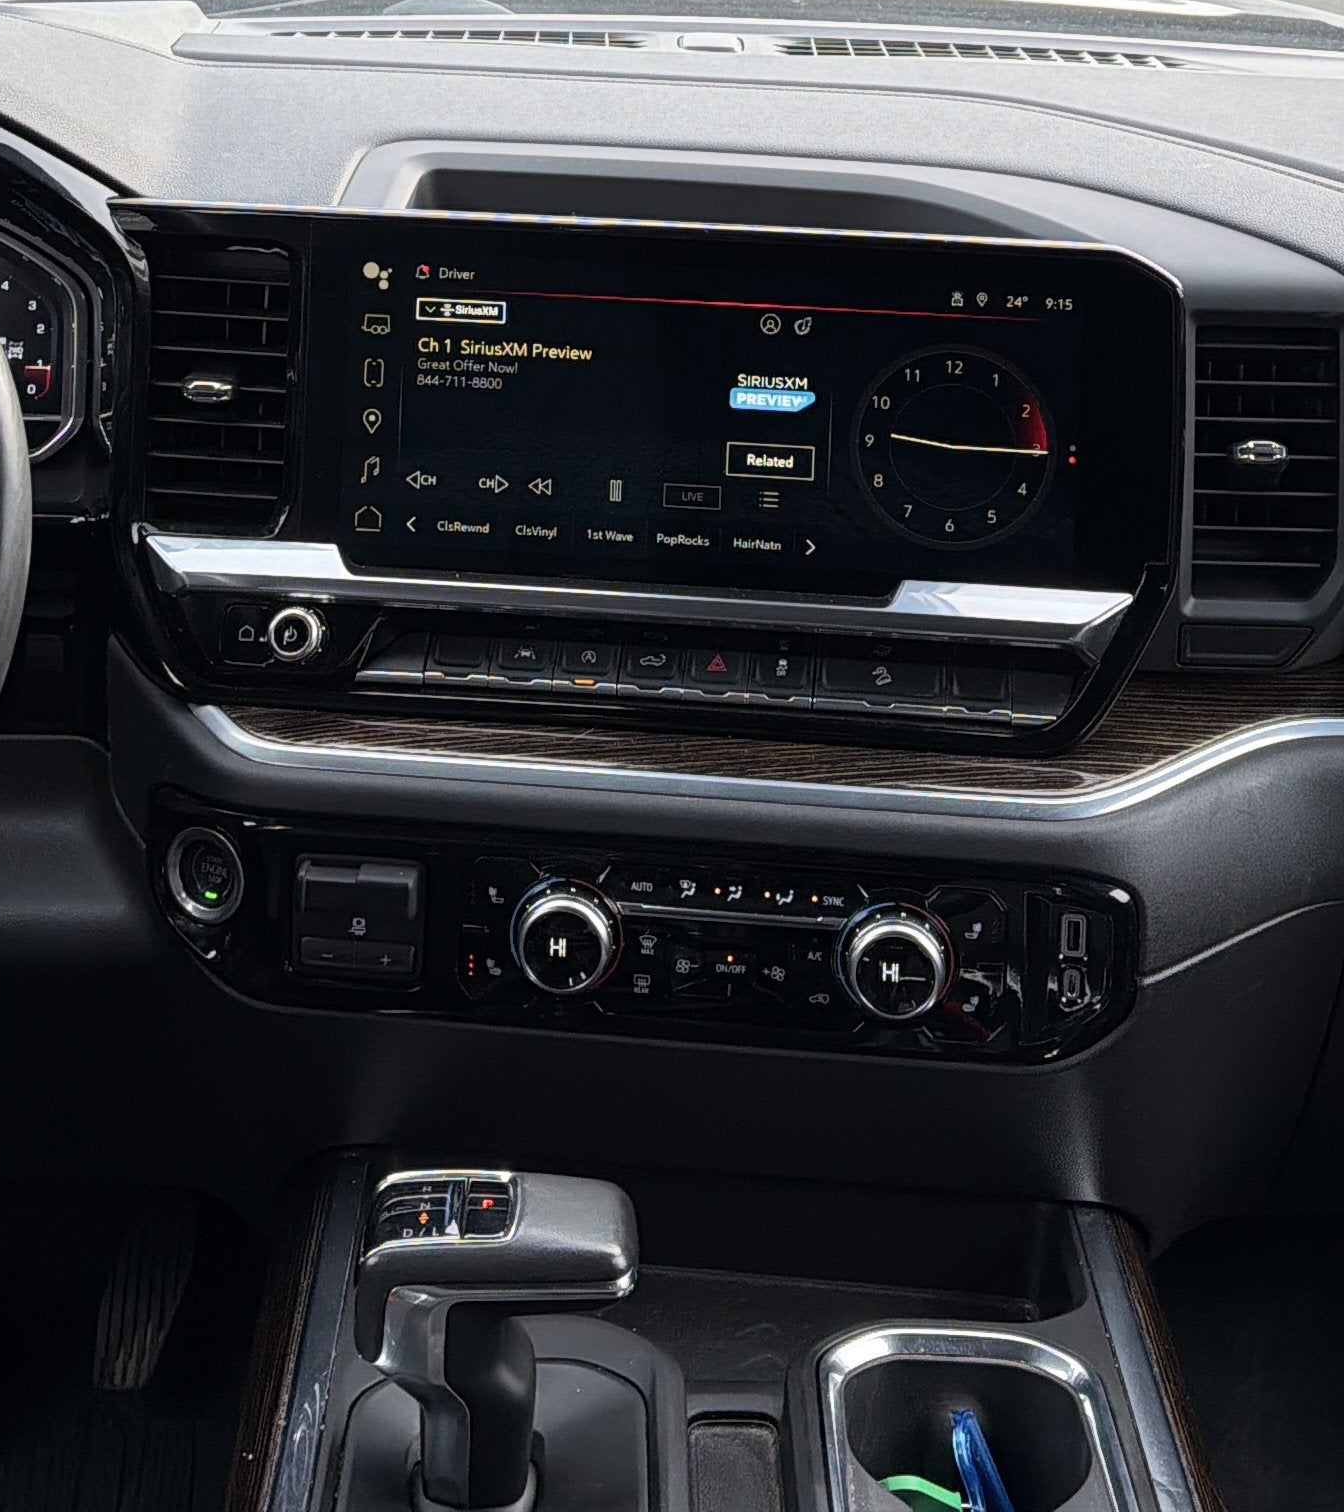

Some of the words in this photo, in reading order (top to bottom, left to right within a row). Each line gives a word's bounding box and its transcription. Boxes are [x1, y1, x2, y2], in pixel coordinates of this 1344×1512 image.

[438, 267, 476, 281] Driver
[0, 281, 9, 291] 4
[28, 301, 37, 311] 3
[1006, 294, 1029, 309] 24°
[1045, 297, 1073, 311] 9:15
[455, 304, 499, 317] SiriusXM
[36, 324, 45, 334] 2
[418, 338, 439, 354] Ch
[444, 339, 451, 354] 1
[460, 340, 528, 357] SiriusXM
[532, 344, 593, 361] Preview
[417, 358, 451, 371] Great
[453, 359, 485, 374] Offer
[488, 362, 518, 375] Now!
[945, 360, 964, 375] 12
[416, 374, 503, 390] 844-711-8800
[737, 374, 809, 390] SIRIUSXM
[904, 369, 921, 382] 11
[992, 373, 1000, 387] 1
[27, 384, 36, 394] 0
[736, 393, 805, 408] PREVIEW
[872, 396, 891, 410] 10
[1020, 404, 1031, 418] 2
[864, 433, 875, 448] 9
[746, 453, 794, 469] Related
[420, 473, 436, 486] CH
[478, 478, 495, 490] CH
[873, 474, 884, 488] 8
[1017, 482, 1028, 496] 4
[681, 491, 704, 503] LIVE
[903, 504, 913, 518] 7
[987, 510, 997, 524] 5
[437, 520, 490, 535] ClsRewnd
[515, 524, 557, 540] ClsVinyl
[945, 519, 955, 533] 6
[586, 528, 604, 541] 1st
[606, 530, 634, 542] Wave
[657, 533, 710, 548] PopRocks
[733, 537, 782, 551] HairNatn
[631, 882, 654, 893] AUTO
[822, 895, 845, 908] SYNC
[549, 937, 567, 958] HI
[807, 951, 823, 961] A/C
[715, 963, 747, 975] ON/OFF
[881, 961, 900, 983] HI
[420, 1201, 431, 1210] N
[482, 1199, 495, 1209] P
